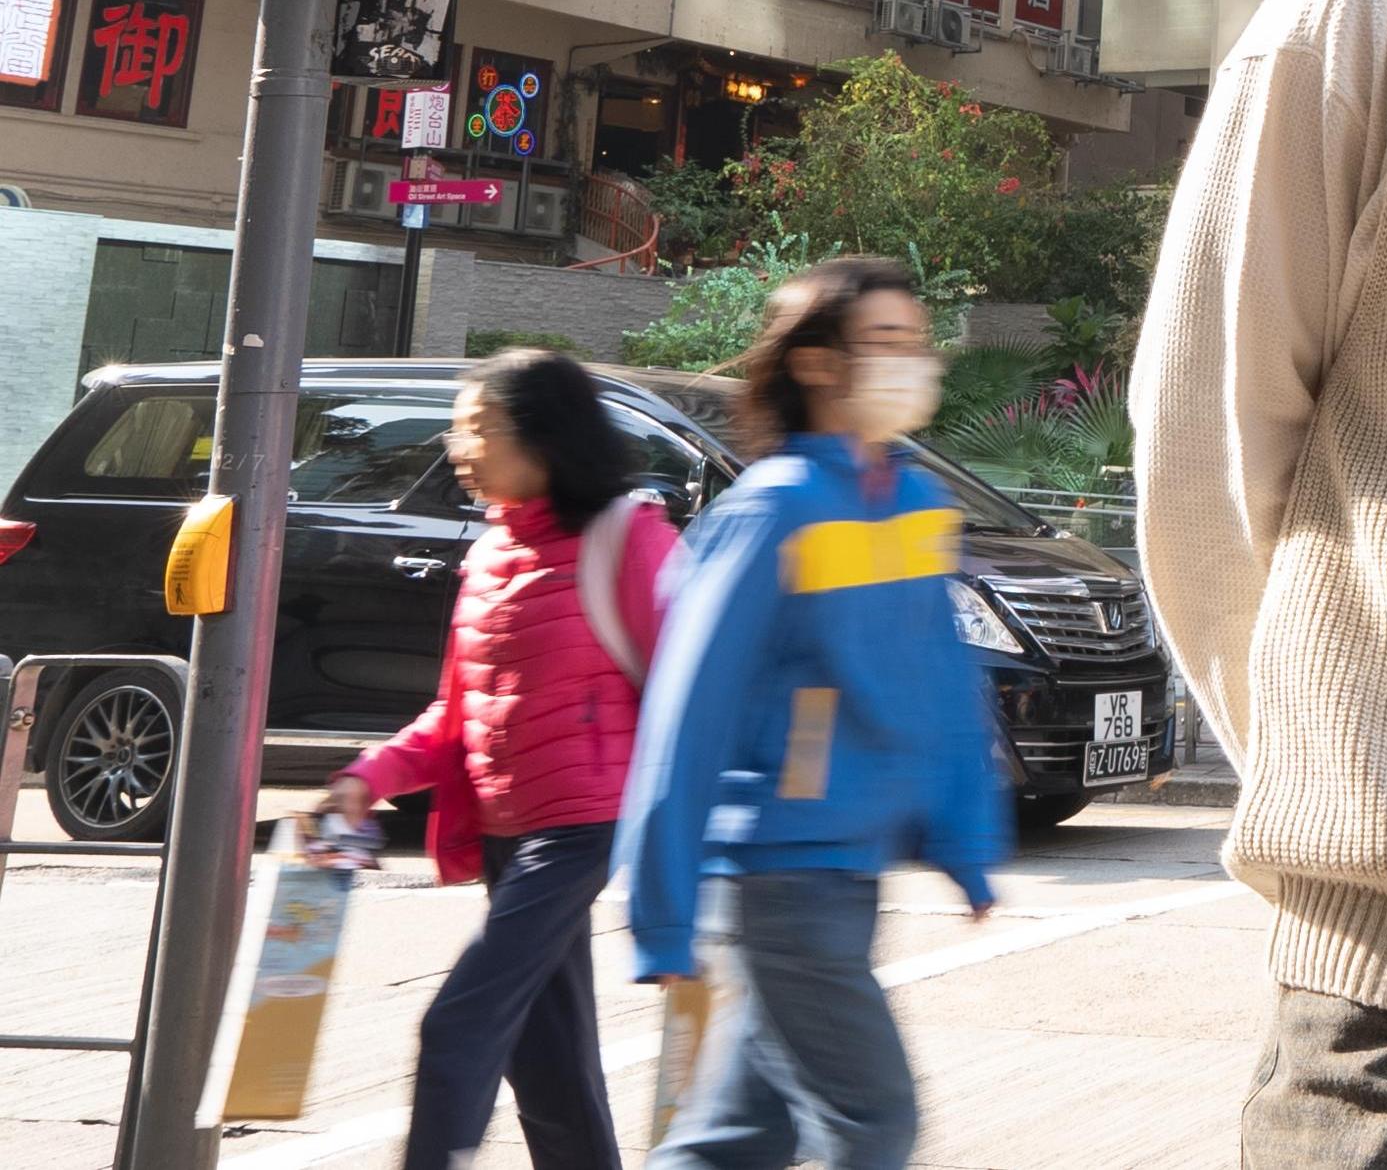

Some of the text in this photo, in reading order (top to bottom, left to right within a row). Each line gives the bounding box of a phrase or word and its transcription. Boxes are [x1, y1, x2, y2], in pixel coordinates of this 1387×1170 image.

[94, 0, 190, 109] 御
[426, 93, 446, 147] 炮台山
[1109, 693, 1129, 717] VR
[1103, 715, 1134, 740] 768
